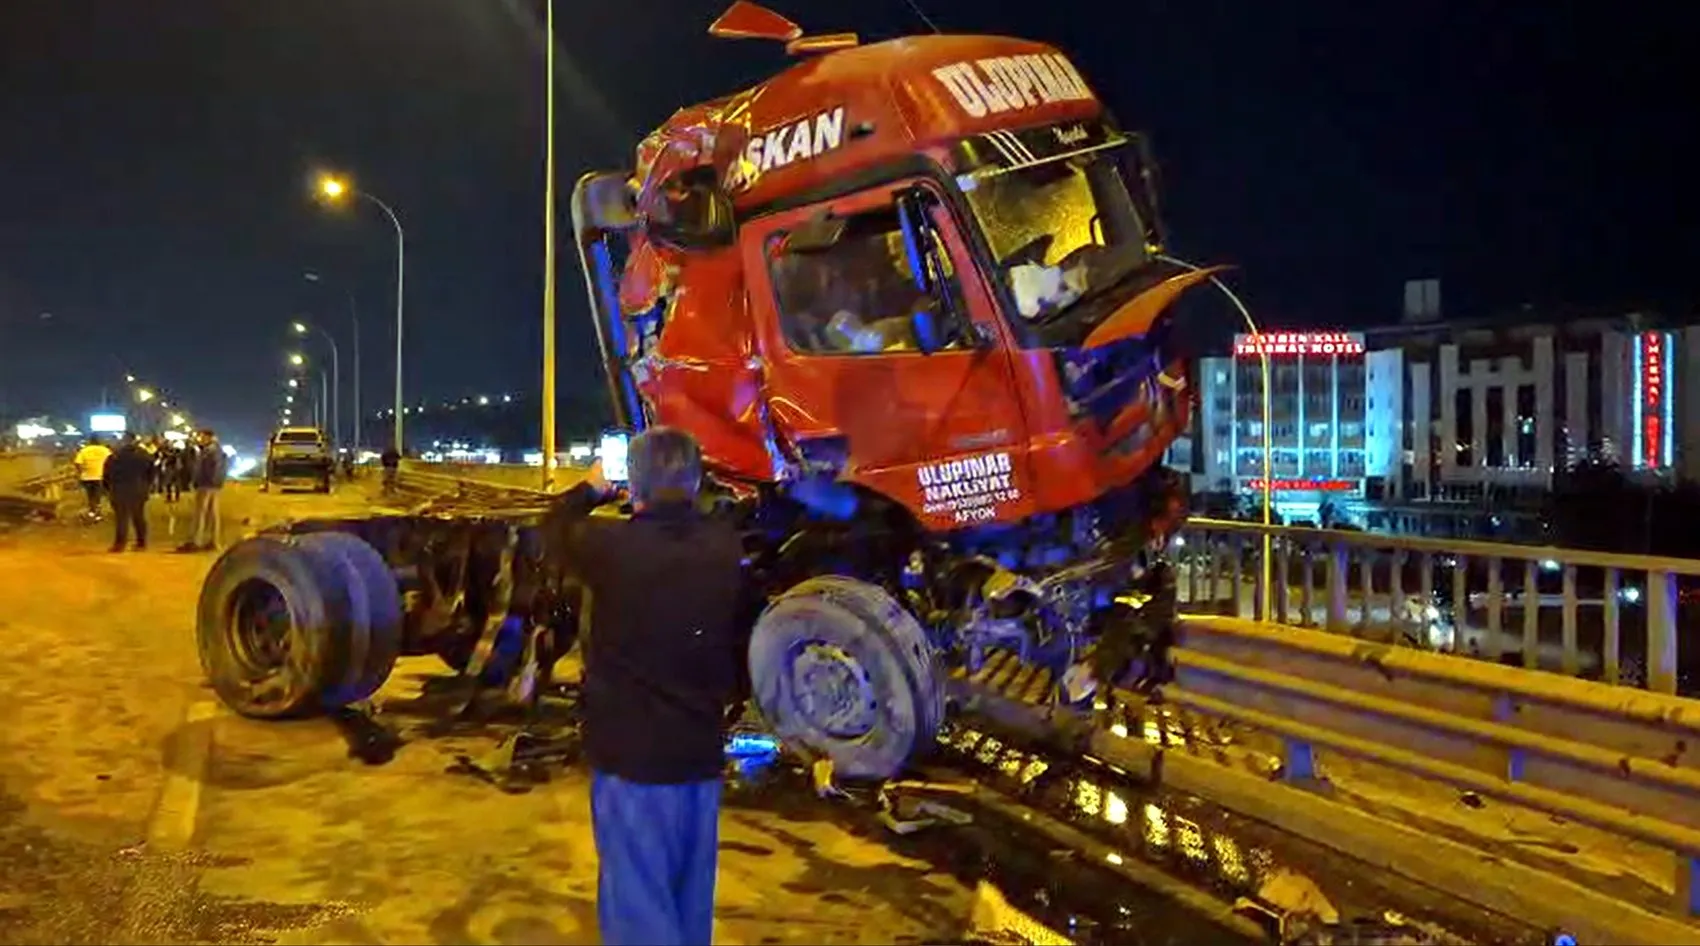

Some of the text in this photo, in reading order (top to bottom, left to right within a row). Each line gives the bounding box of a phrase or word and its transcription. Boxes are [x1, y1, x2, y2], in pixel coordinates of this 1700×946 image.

[1237, 343, 1363, 353] THERMAL HOTEL
[918, 453, 1011, 486] ULUPINAR
